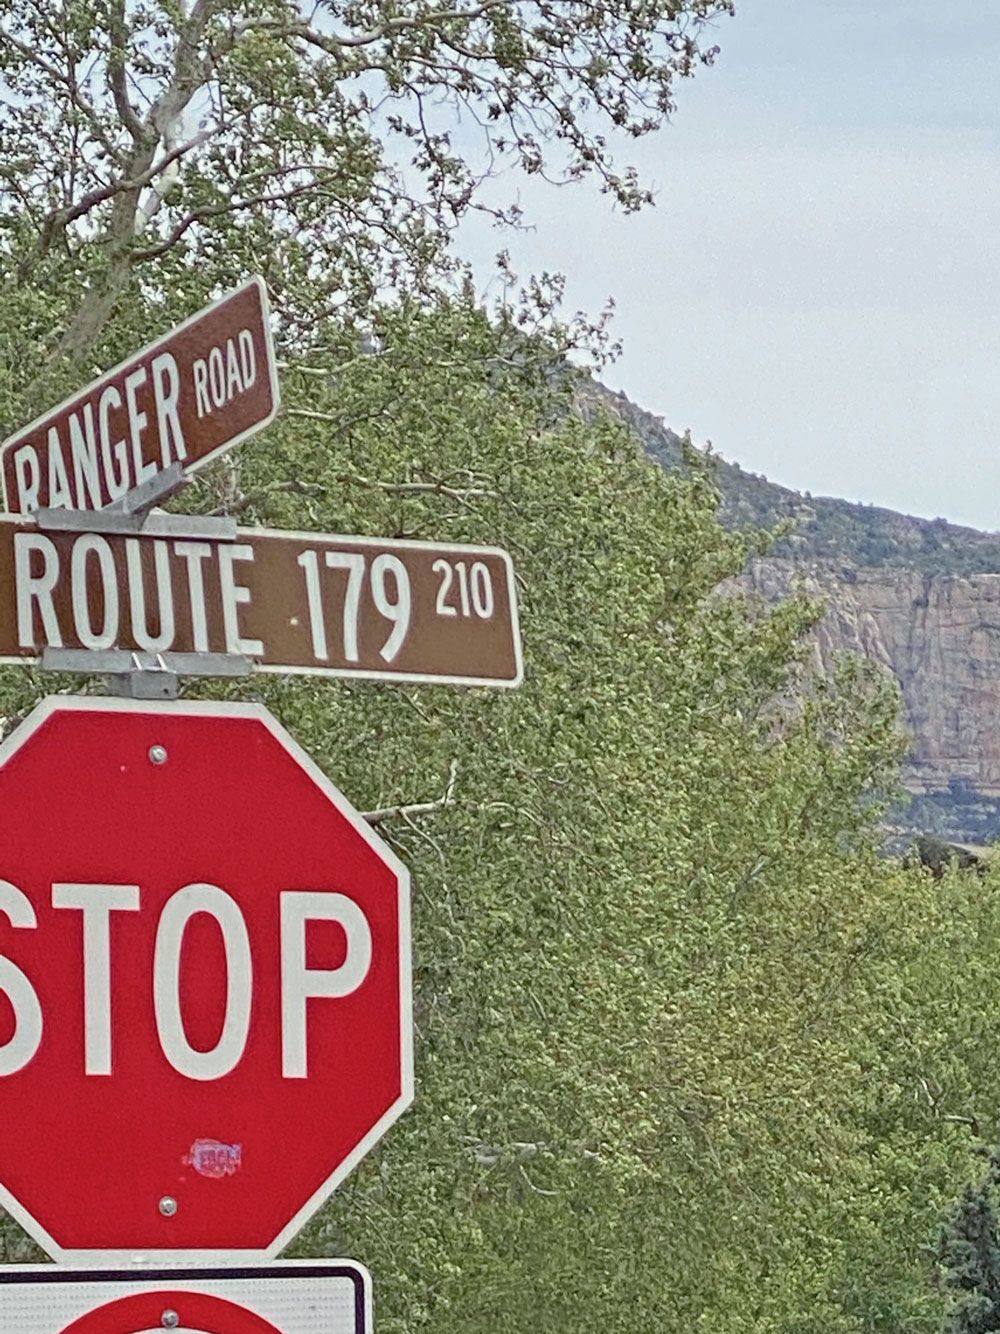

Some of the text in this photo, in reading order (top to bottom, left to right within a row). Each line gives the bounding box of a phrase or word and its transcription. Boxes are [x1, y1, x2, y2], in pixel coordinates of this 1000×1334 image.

[14, 329, 255, 513] RANGER ROAD
[14, 532, 494, 664] ROUTE 179 210
